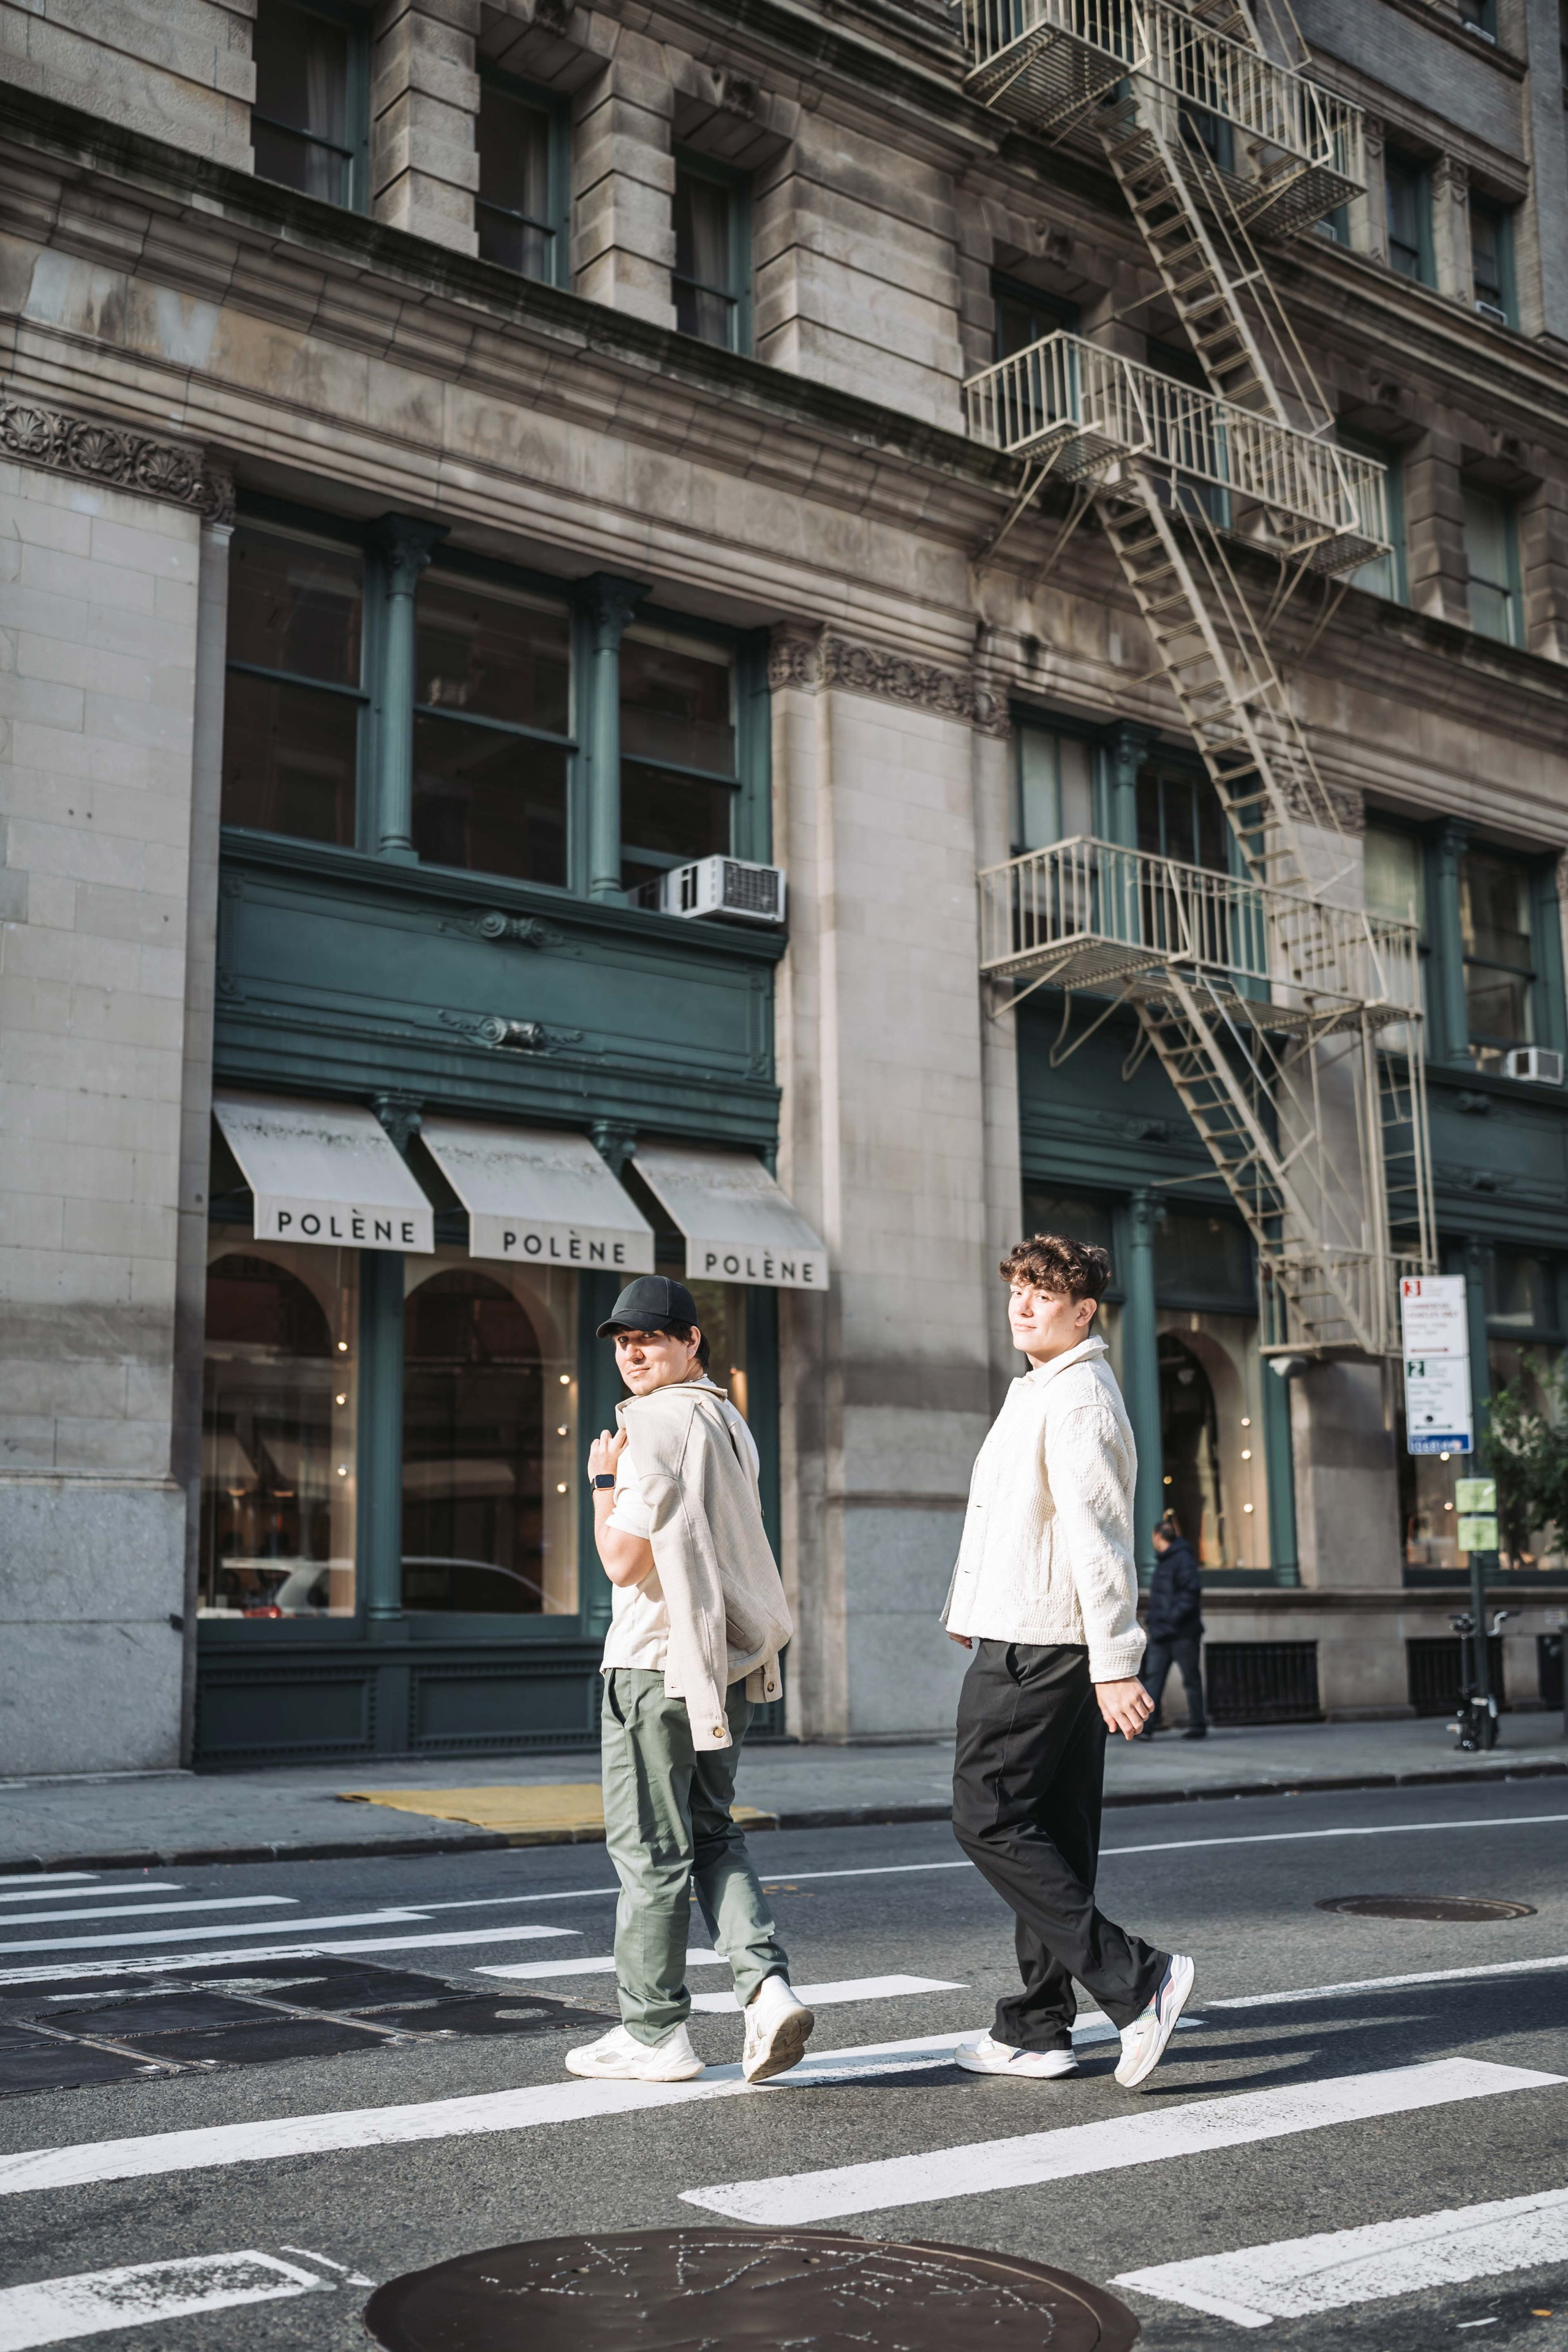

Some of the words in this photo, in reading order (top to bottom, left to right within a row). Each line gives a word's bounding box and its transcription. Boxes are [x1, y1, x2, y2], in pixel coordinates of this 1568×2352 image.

[277, 1208, 415, 1243] POLÈNE
[503, 1231, 625, 1264] POLÈNE
[705, 1251, 813, 1282] POLÈNE
[1408, 1281, 1418, 1297] 3
[1411, 1362, 1420, 1377] 2
